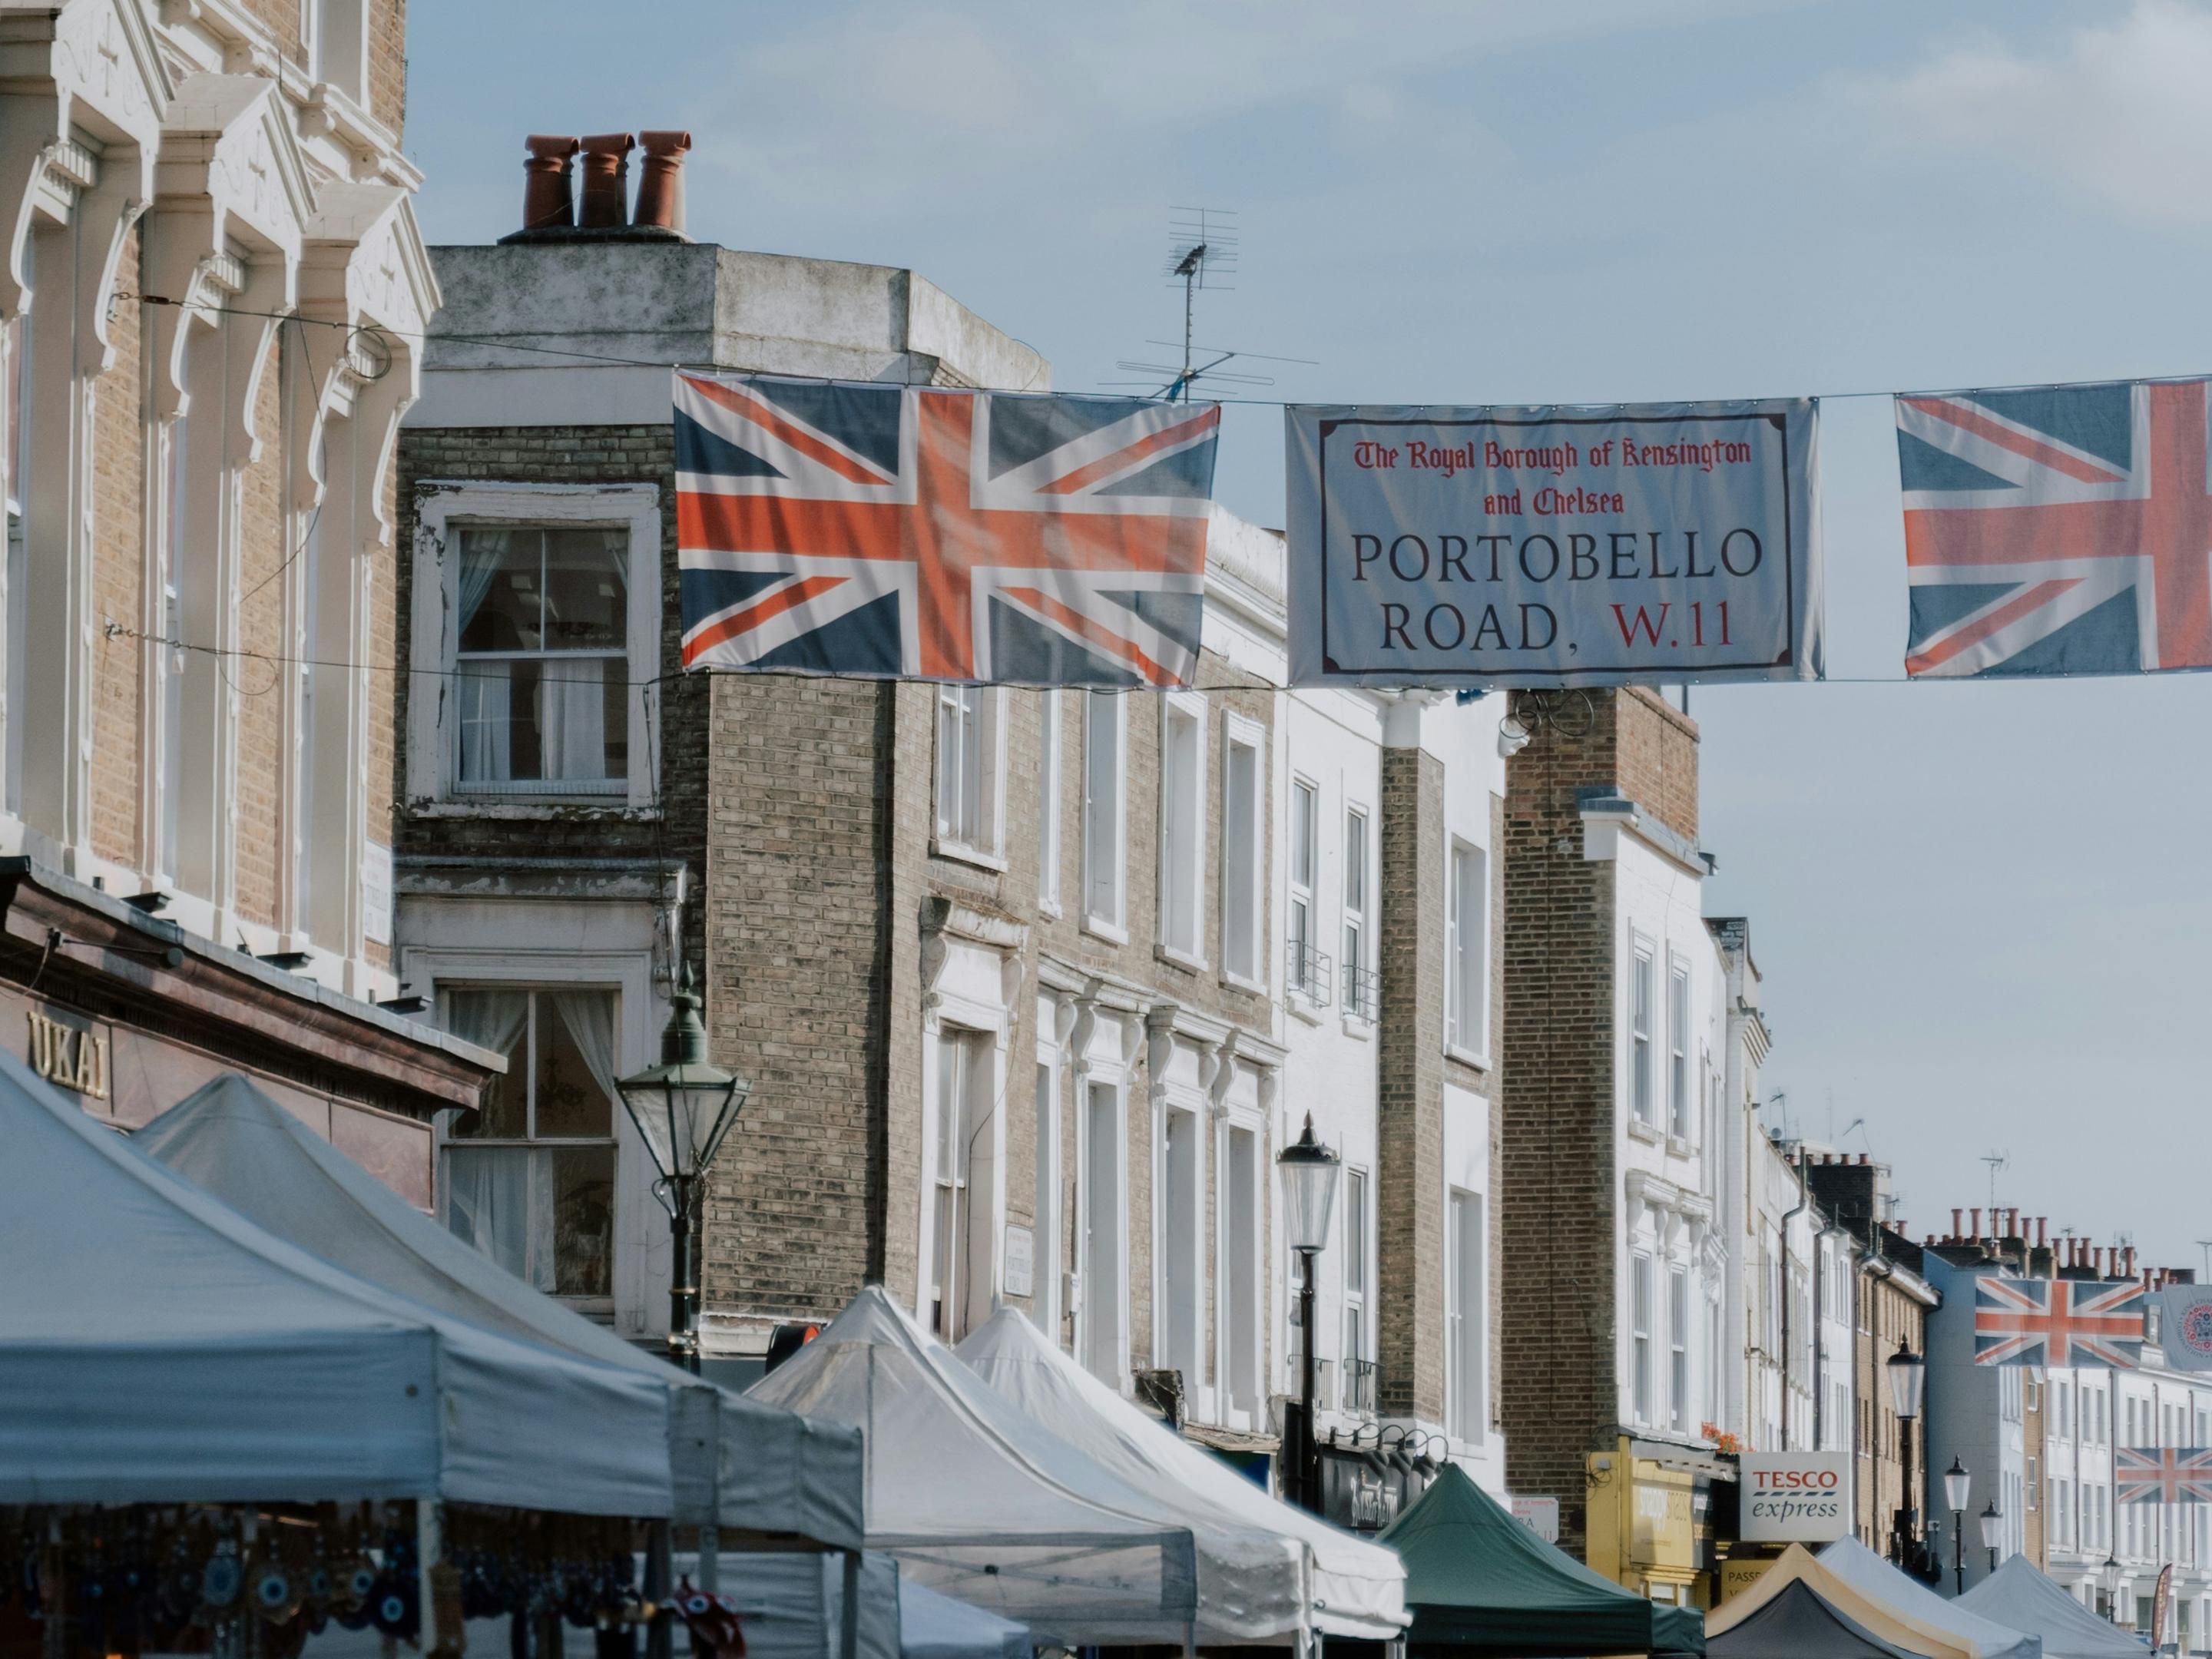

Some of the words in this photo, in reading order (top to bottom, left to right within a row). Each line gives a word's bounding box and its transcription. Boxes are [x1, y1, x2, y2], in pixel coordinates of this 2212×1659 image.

[1354, 441, 1399, 470] The
[1406, 440, 1475, 478] Royal
[1485, 440, 1578, 476] Borough
[1589, 439, 1617, 467] of
[1622, 435, 1751, 472] Kensington
[1484, 488, 1522, 515] and
[1533, 486, 1624, 516] Chelsea
[1351, 528, 1763, 583] PORTOBELLO
[1379, 602, 1579, 656] ROAD,
[1611, 600, 1734, 647] W.11
[27, 1011, 110, 1098] UKAI
[1752, 1471, 1838, 1488] TESCO
[1752, 1500, 1838, 1524] express
